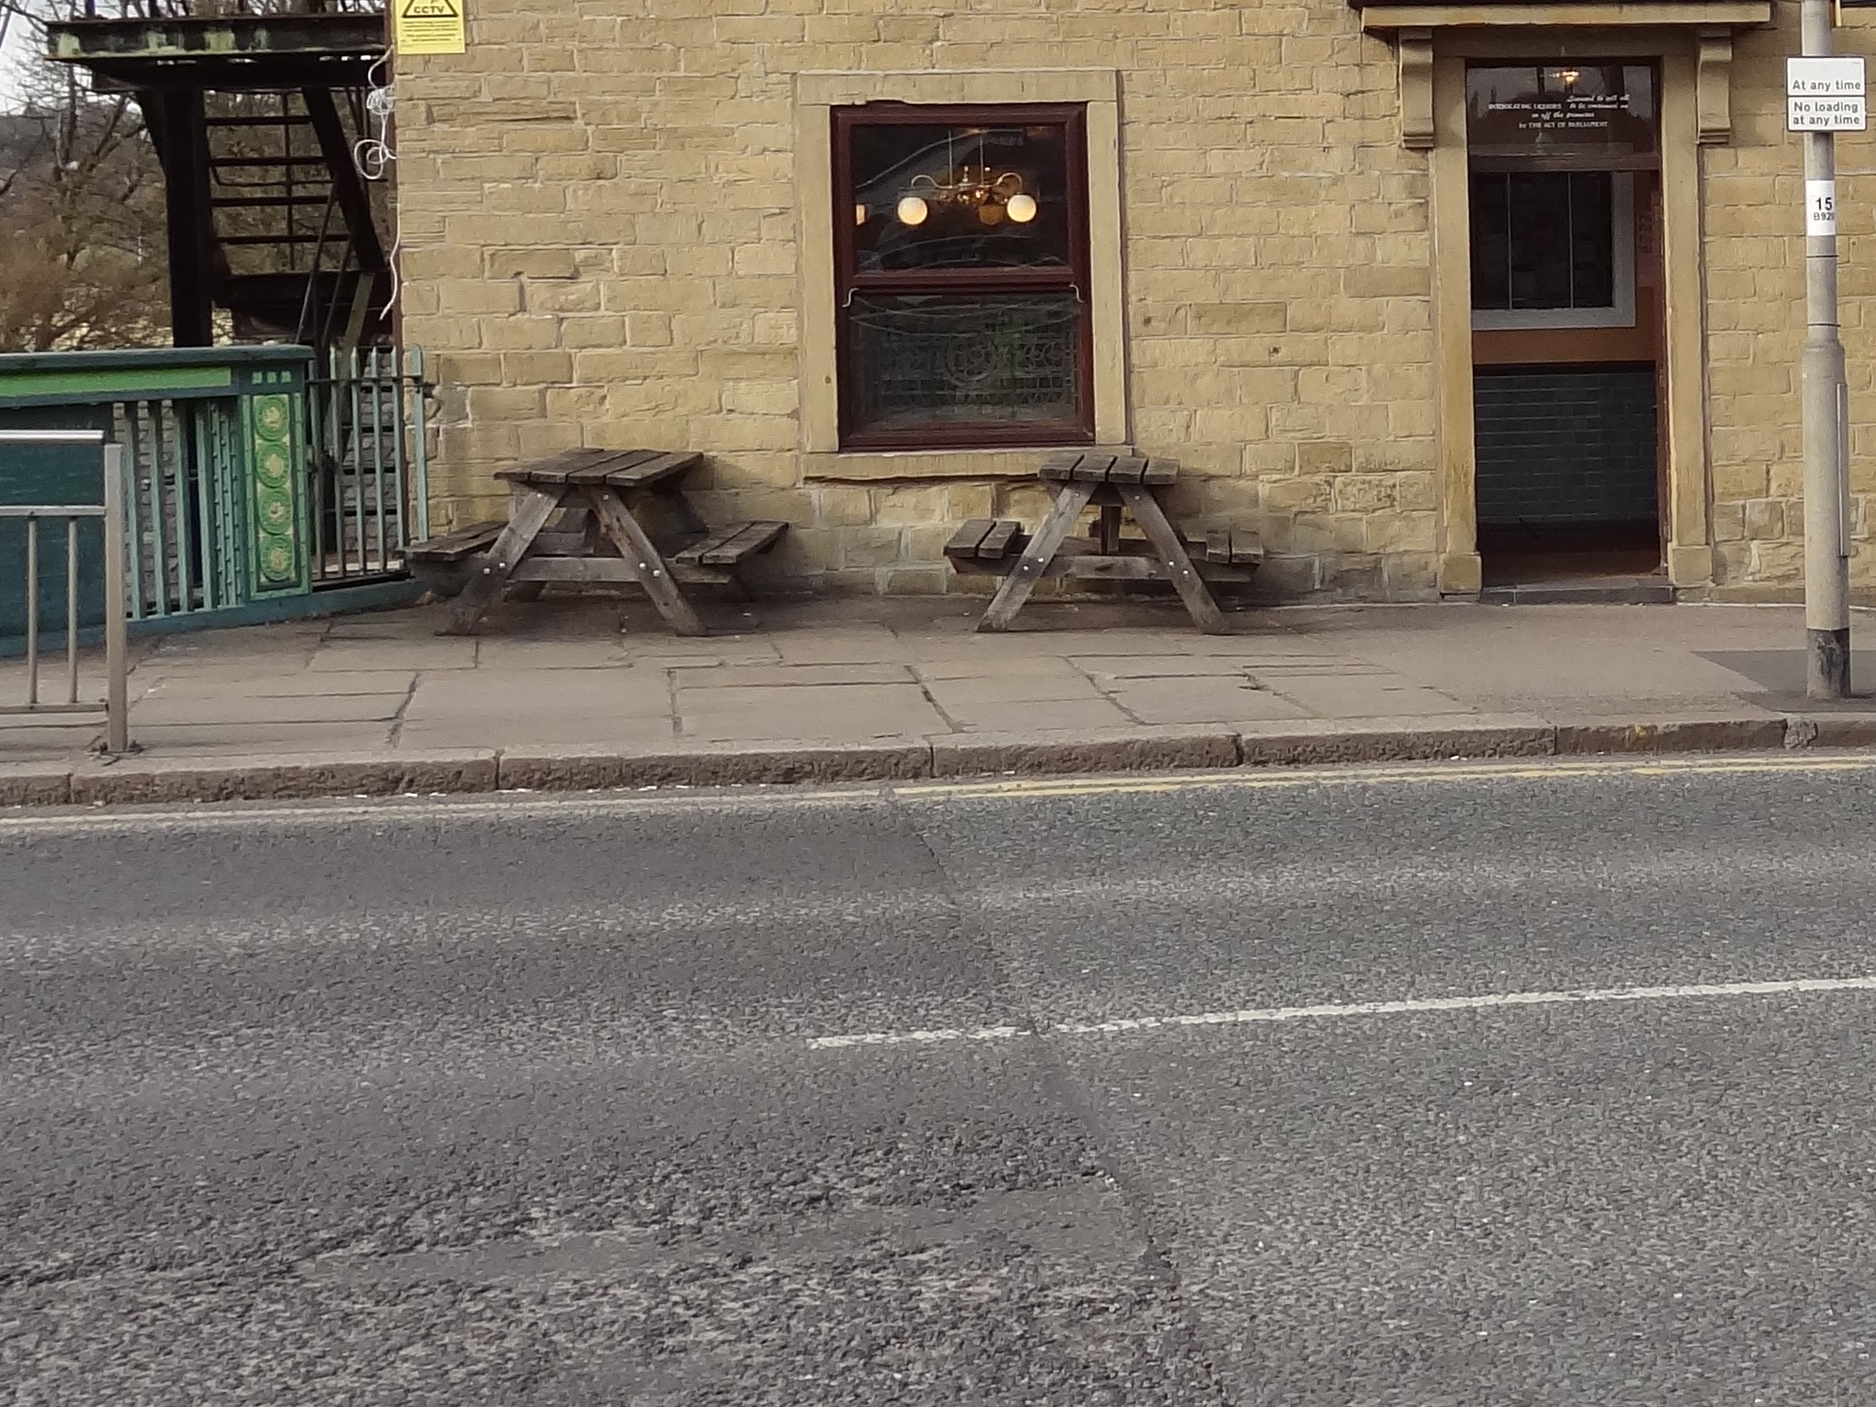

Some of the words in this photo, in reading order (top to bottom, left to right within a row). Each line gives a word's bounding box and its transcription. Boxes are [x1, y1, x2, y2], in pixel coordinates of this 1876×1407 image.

[413, 5, 445, 14] CCTV
[1792, 79, 1806, 91] At
[1810, 81, 1831, 92] any
[1835, 80, 1861, 90] time
[1794, 101, 1811, 112] No
[1814, 101, 1858, 113] loading
[1793, 114, 1805, 125] at
[1809, 116, 1829, 126] any
[1834, 114, 1860, 125] time
[1815, 197, 1832, 211] 15
